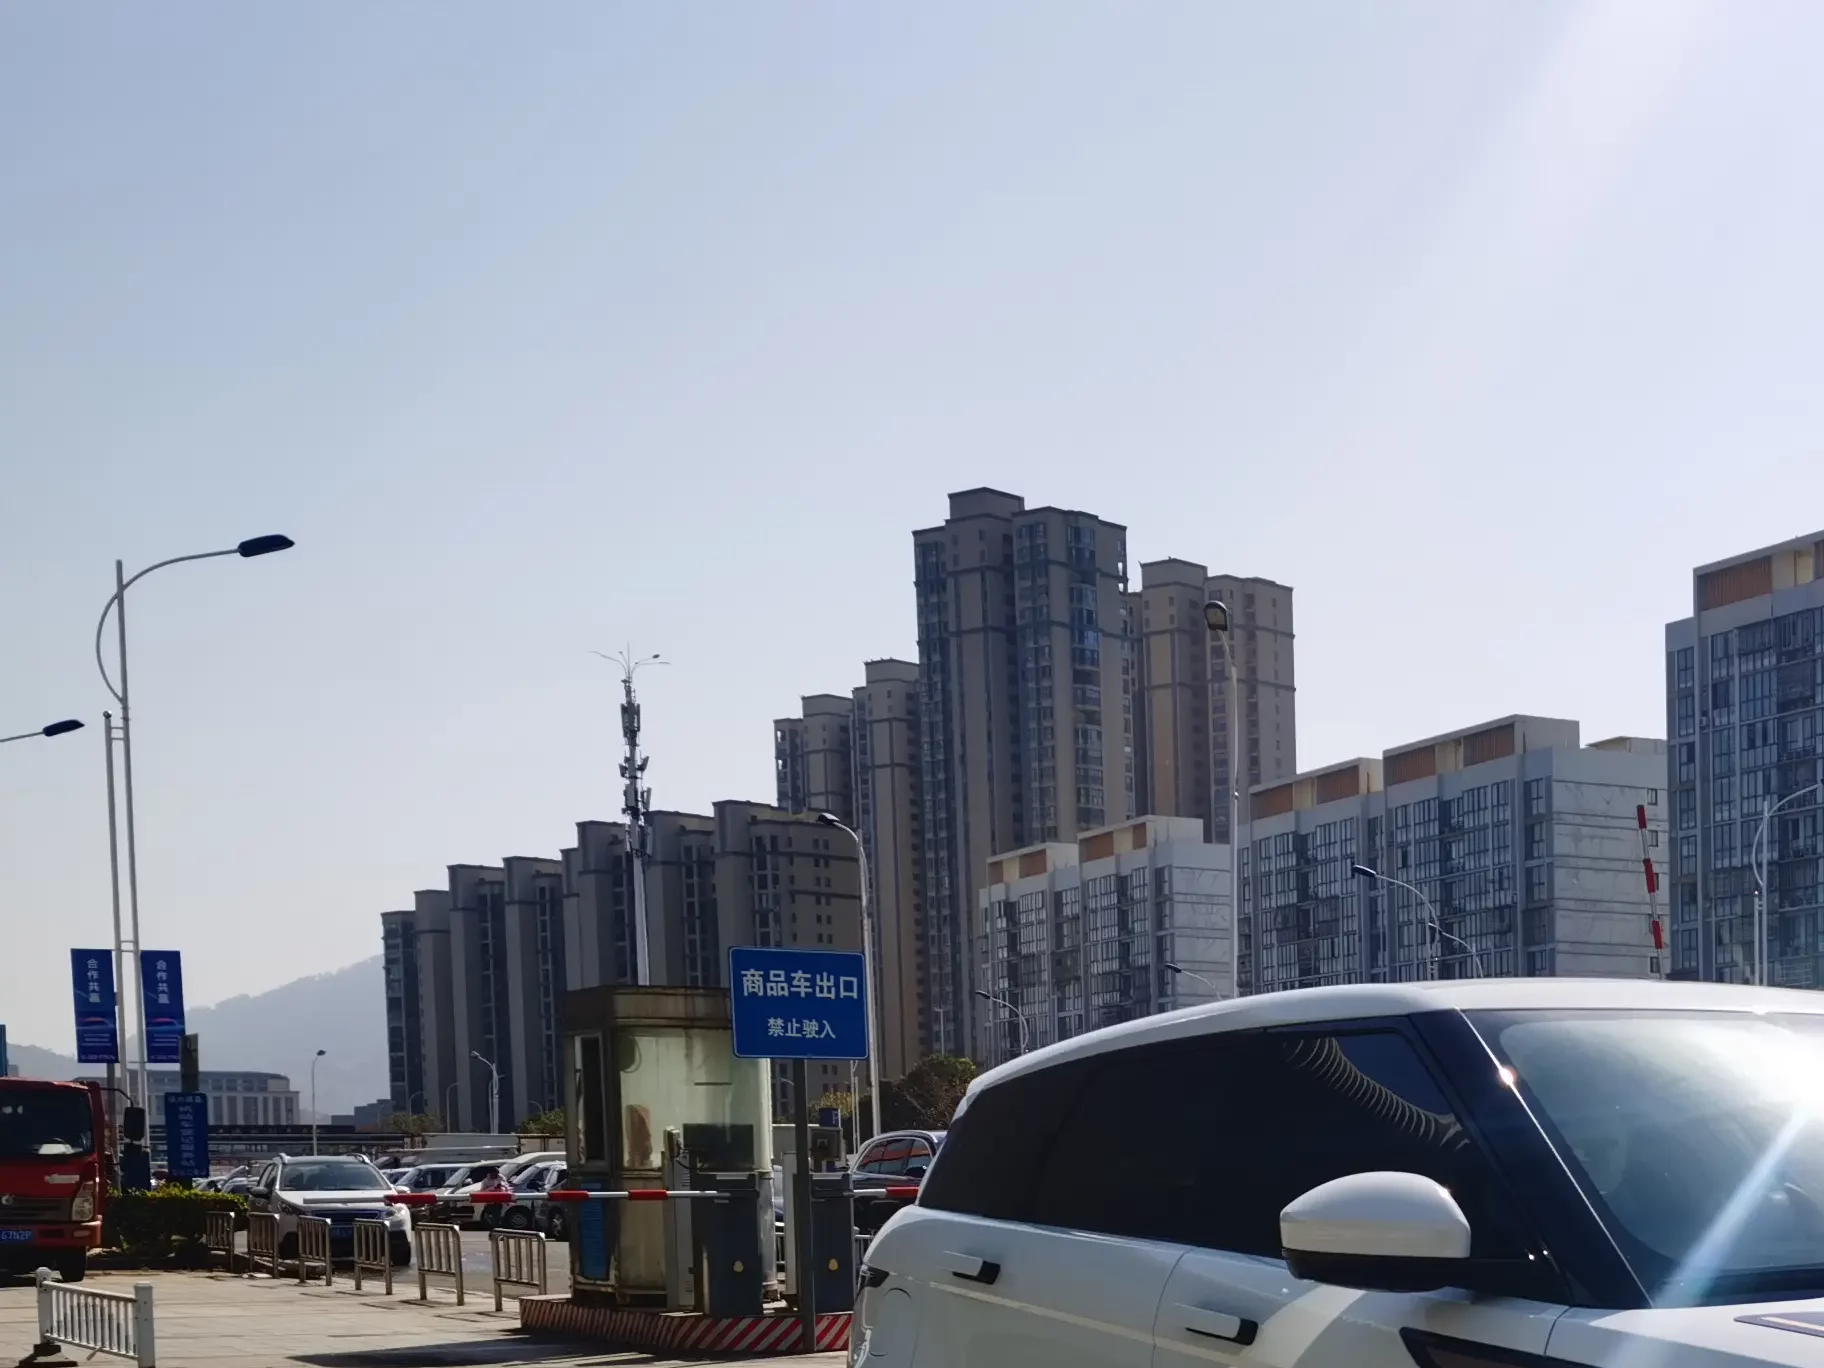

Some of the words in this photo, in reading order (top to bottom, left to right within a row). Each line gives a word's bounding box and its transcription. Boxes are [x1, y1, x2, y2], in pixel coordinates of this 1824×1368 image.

[741, 969, 858, 999] 商品车出口
[767, 1017, 836, 1039] 禁止驶入
